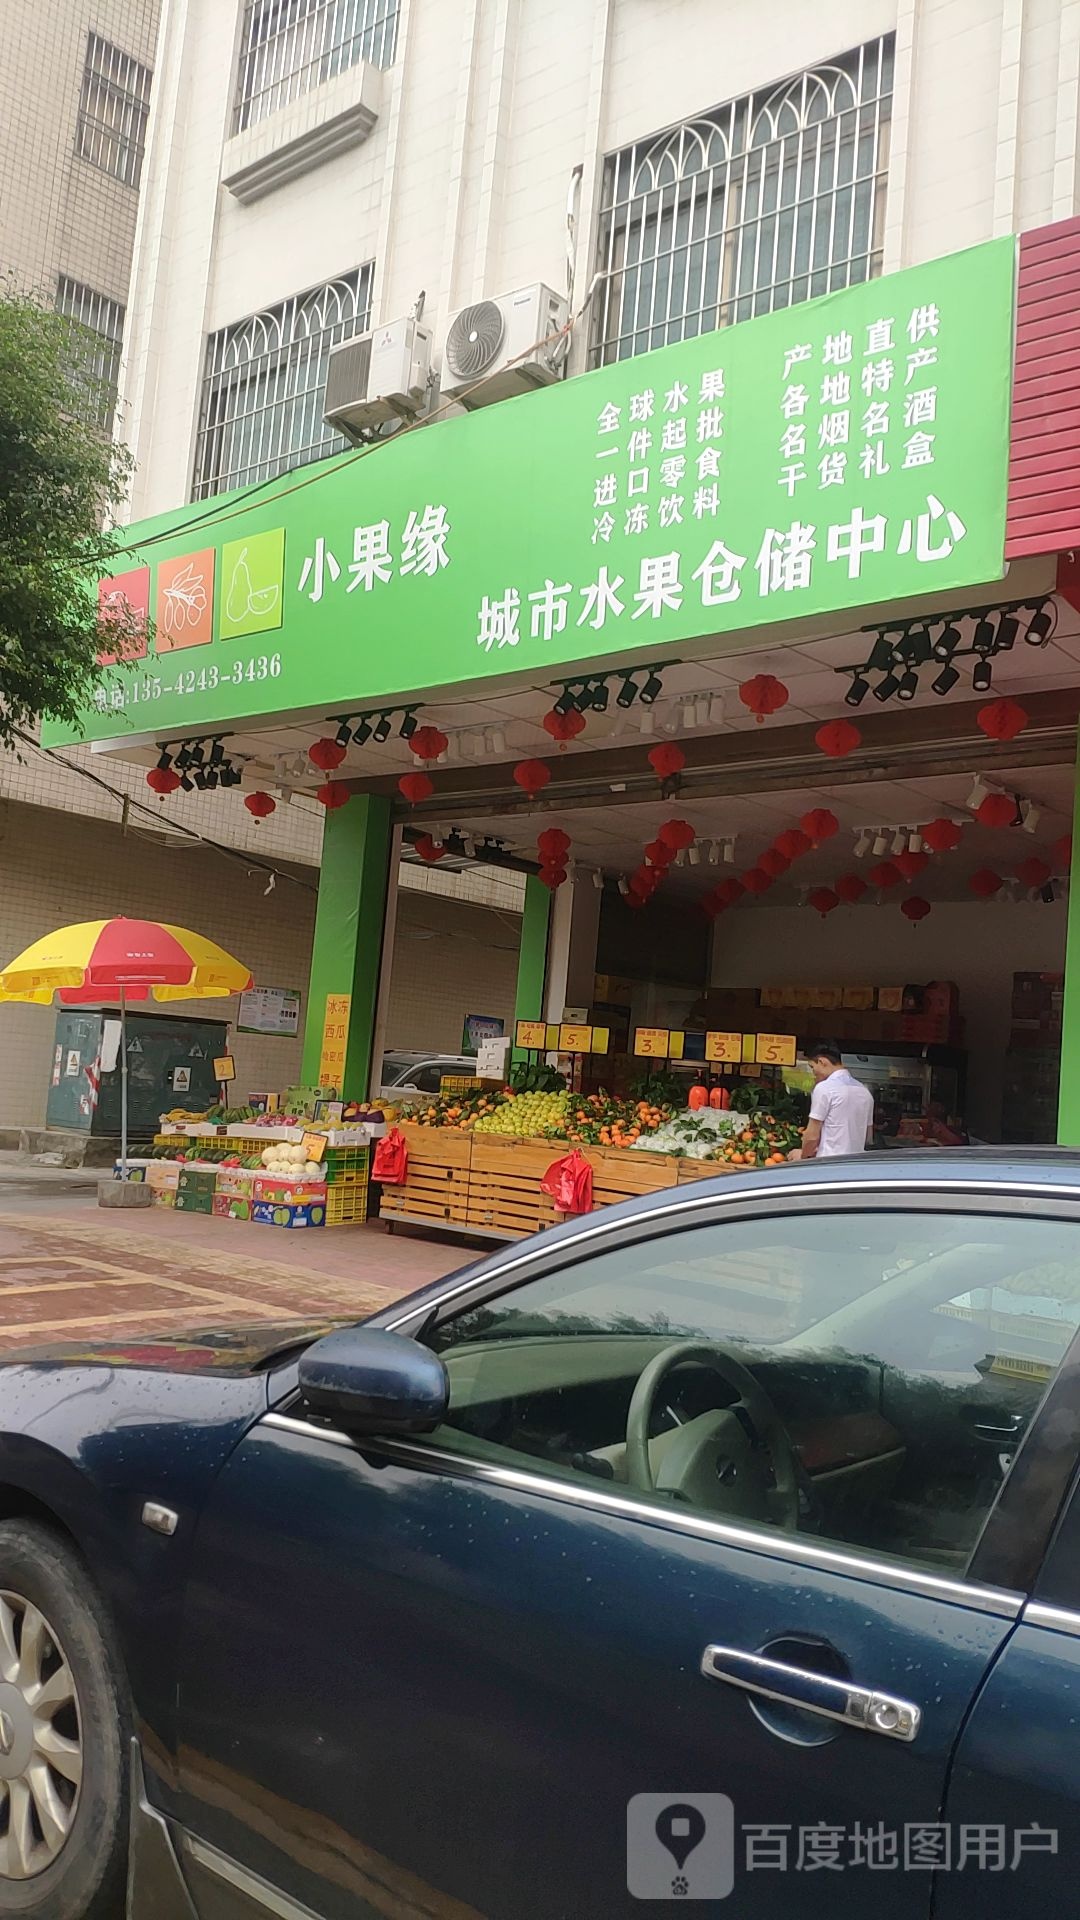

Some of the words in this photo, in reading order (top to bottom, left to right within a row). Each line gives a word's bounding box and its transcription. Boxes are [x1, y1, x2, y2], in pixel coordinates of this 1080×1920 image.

[781, 302, 941, 380] 产地直供
[596, 368, 725, 437] 全球水果
[779, 346, 939, 421] 各地特产
[595, 406, 724, 464] 一件起批
[777, 385, 938, 460] 名烟名酒
[592, 446, 722, 509] 进口零食
[777, 430, 936, 498] 干货礼盒
[590, 482, 721, 545] 冷冻饮料
[298, 503, 453, 604] 小果缘
[476, 493, 968, 653] 城市水果仓储中心
[325, 1024, 345, 1039] 西瓜
